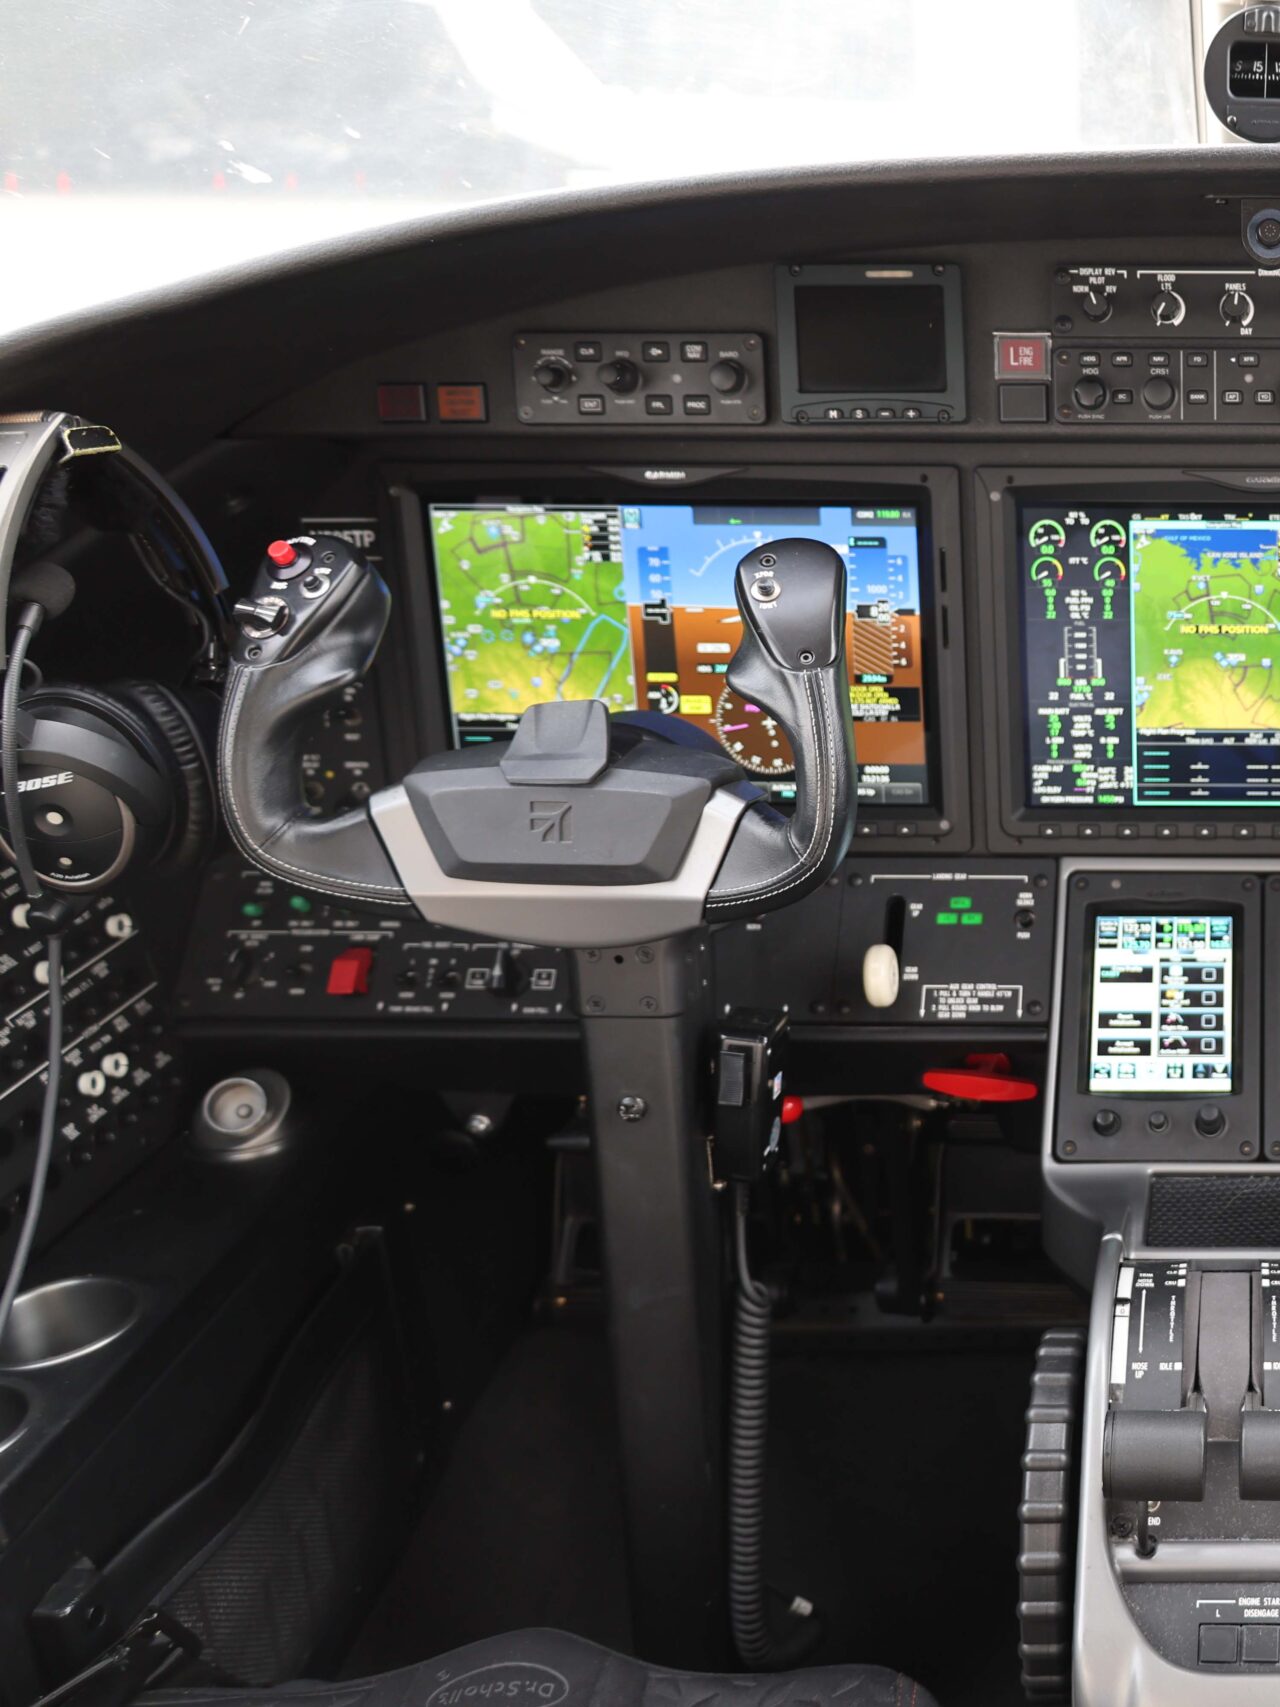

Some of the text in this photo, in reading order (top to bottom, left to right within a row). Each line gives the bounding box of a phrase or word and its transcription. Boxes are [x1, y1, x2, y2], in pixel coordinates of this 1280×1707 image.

[1010, 346, 1018, 366] L
[1181, 625, 1197, 634] NO
[1222, 625, 1268, 634] POSITION
[1132, 1362, 1148, 1370] NOSE
[1160, 1362, 1172, 1370] IDLE
[1147, 1517, 1161, 1526] END
[1244, 1609, 1279, 1617] DISENGAGE
